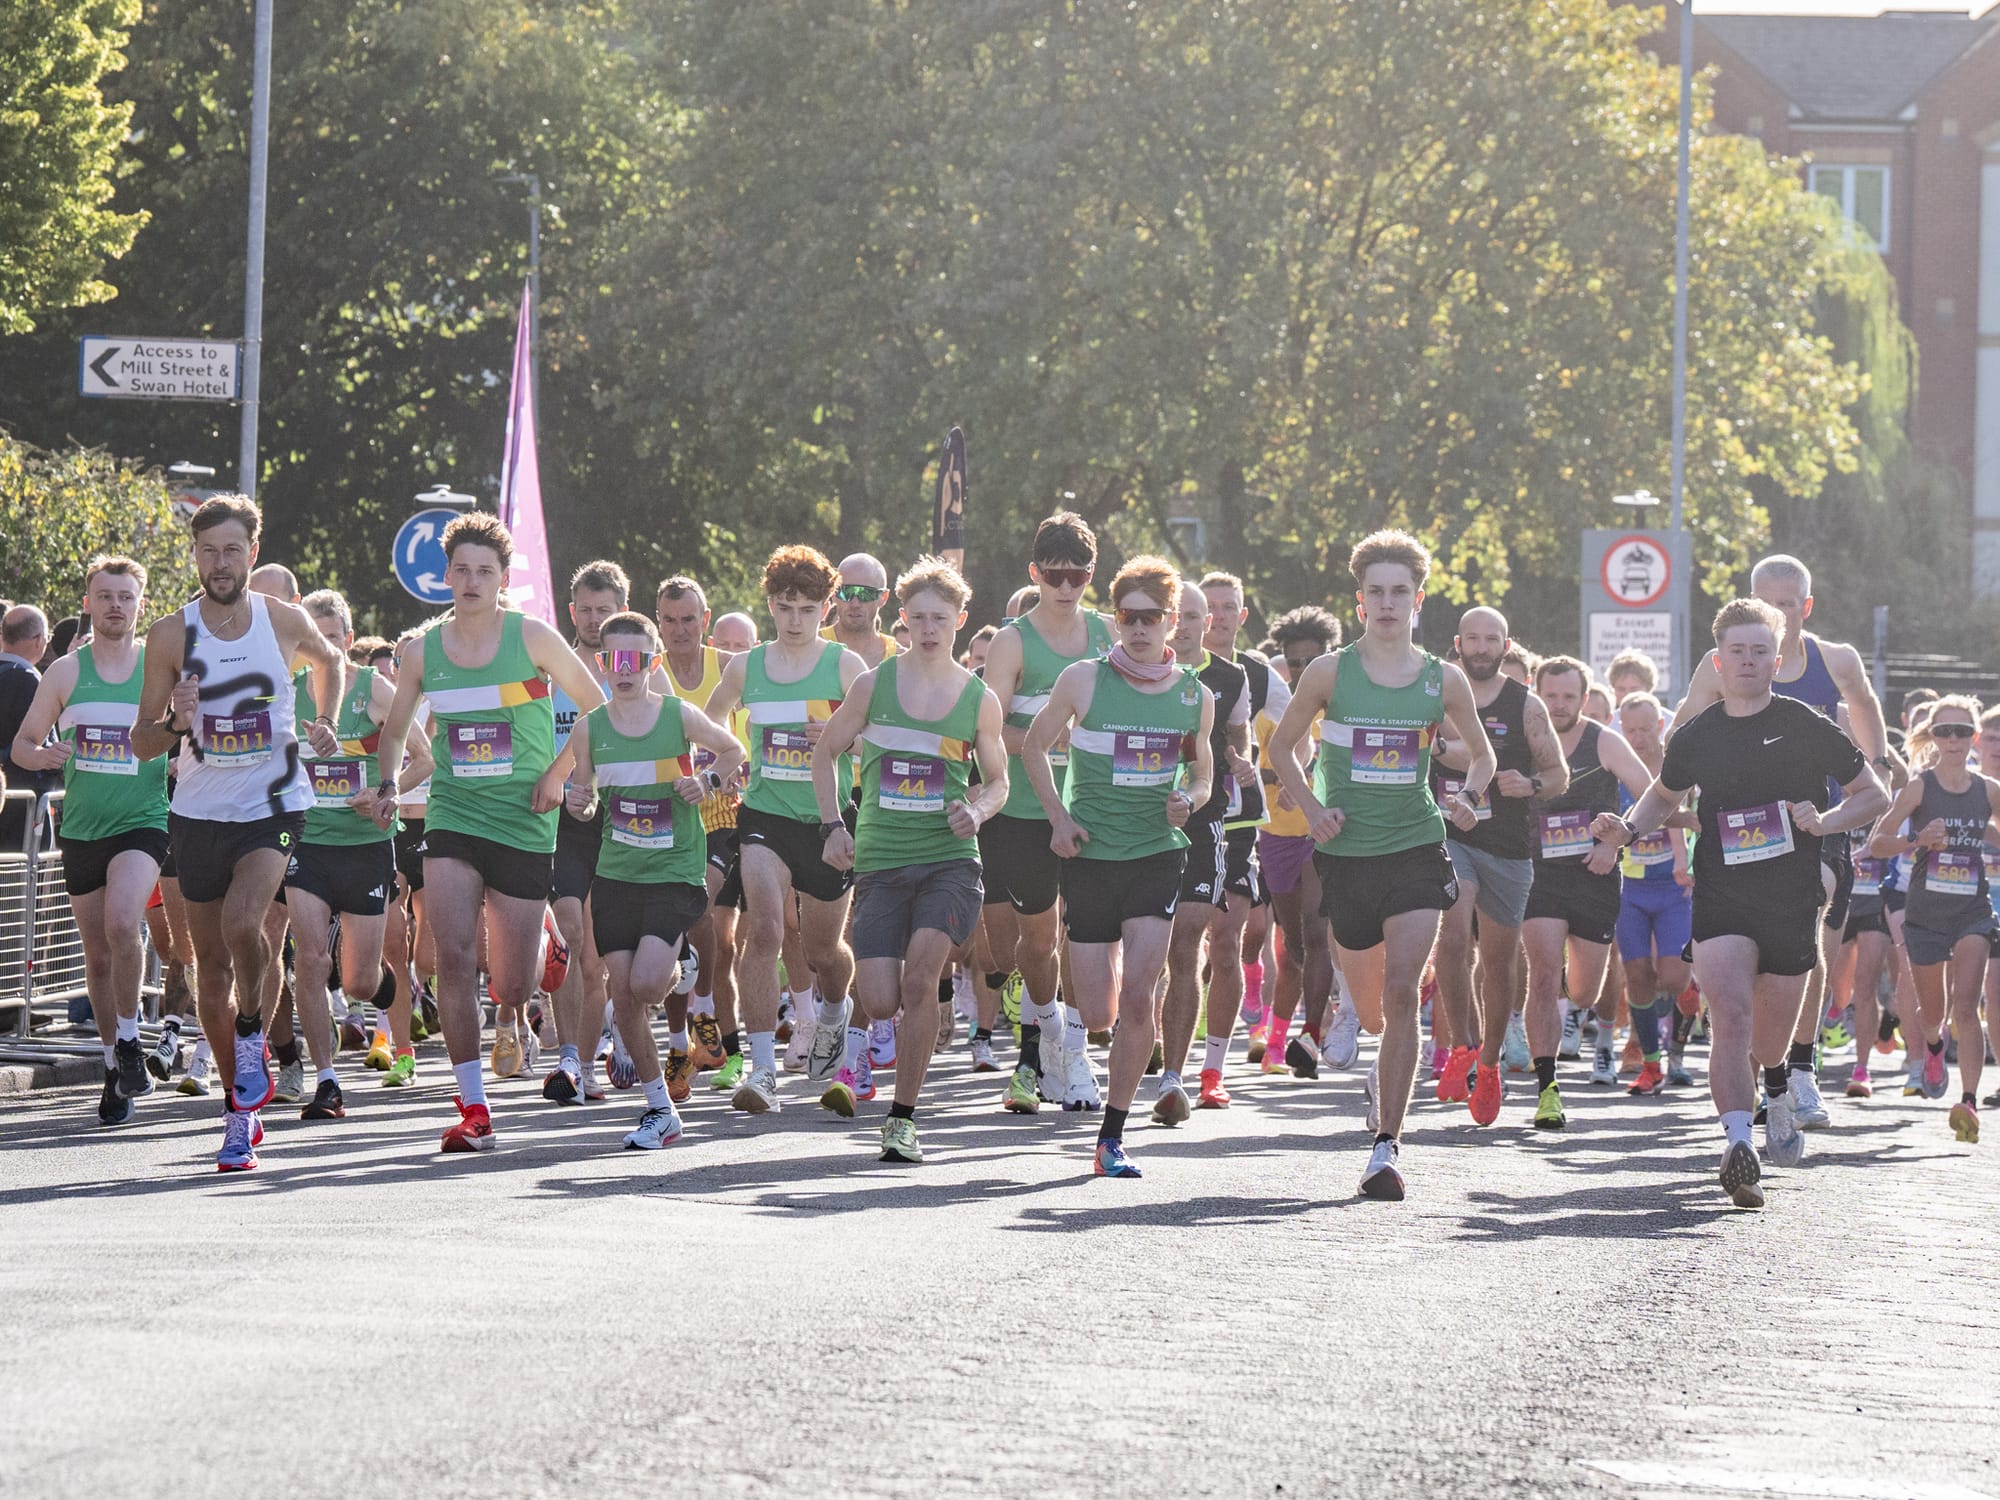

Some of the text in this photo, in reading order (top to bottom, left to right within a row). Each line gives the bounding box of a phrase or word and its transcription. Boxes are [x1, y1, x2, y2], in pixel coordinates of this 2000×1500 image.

[133, 343, 217, 359] Access to
[121, 361, 230, 377] Mill Street &
[131, 378, 227, 394] Swan Hotel
[1615, 617, 1655, 628] Except
[1102, 723, 1138, 731] CANNOCK
[1146, 726, 1180, 734] STAFFORD
[1343, 716, 1379, 724] CANNOCK
[81, 742, 126, 761] 1731
[210, 732, 264, 753] 1011
[466, 742, 493, 763] 38
[1136, 752, 1162, 772] 13
[1371, 750, 1401, 769] 42
[315, 778, 350, 796] 960
[897, 778, 926, 798] 44
[626, 817, 654, 836] 43
[1963, 818, 1975, 827] 4
[1545, 826, 1588, 846] 1213
[1737, 827, 1767, 849] 26
